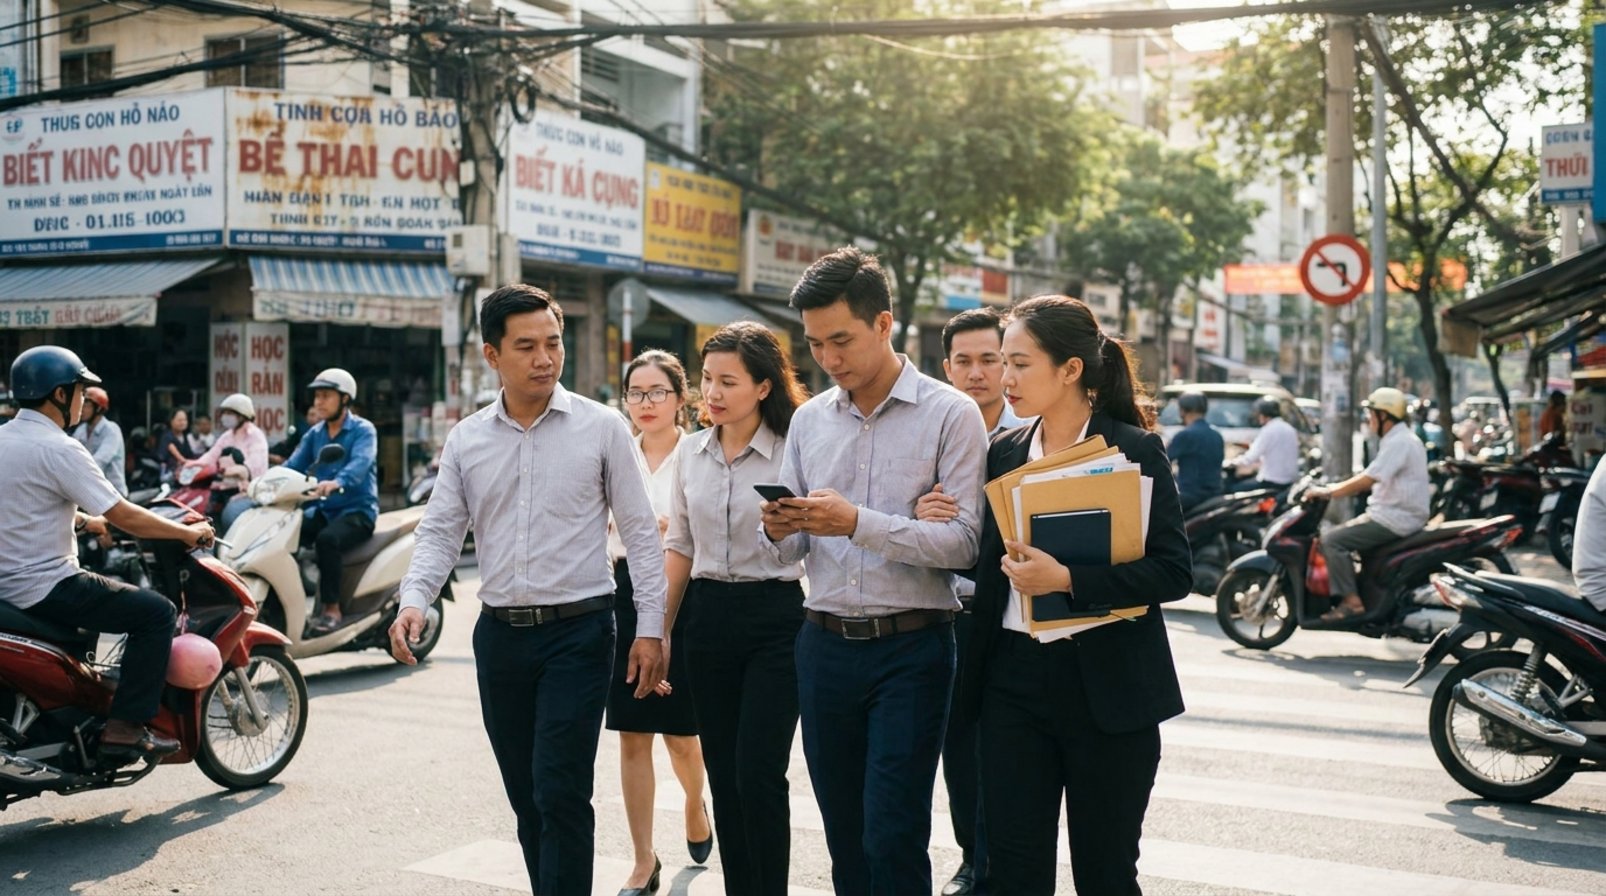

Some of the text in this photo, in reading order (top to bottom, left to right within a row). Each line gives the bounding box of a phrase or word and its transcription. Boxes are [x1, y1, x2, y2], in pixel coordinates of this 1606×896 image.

[86, 111, 115, 129] CON
[128, 129, 214, 183] QUYỆT
[297, 142, 378, 181] THAI
[251, 335, 285, 363] HỌC
